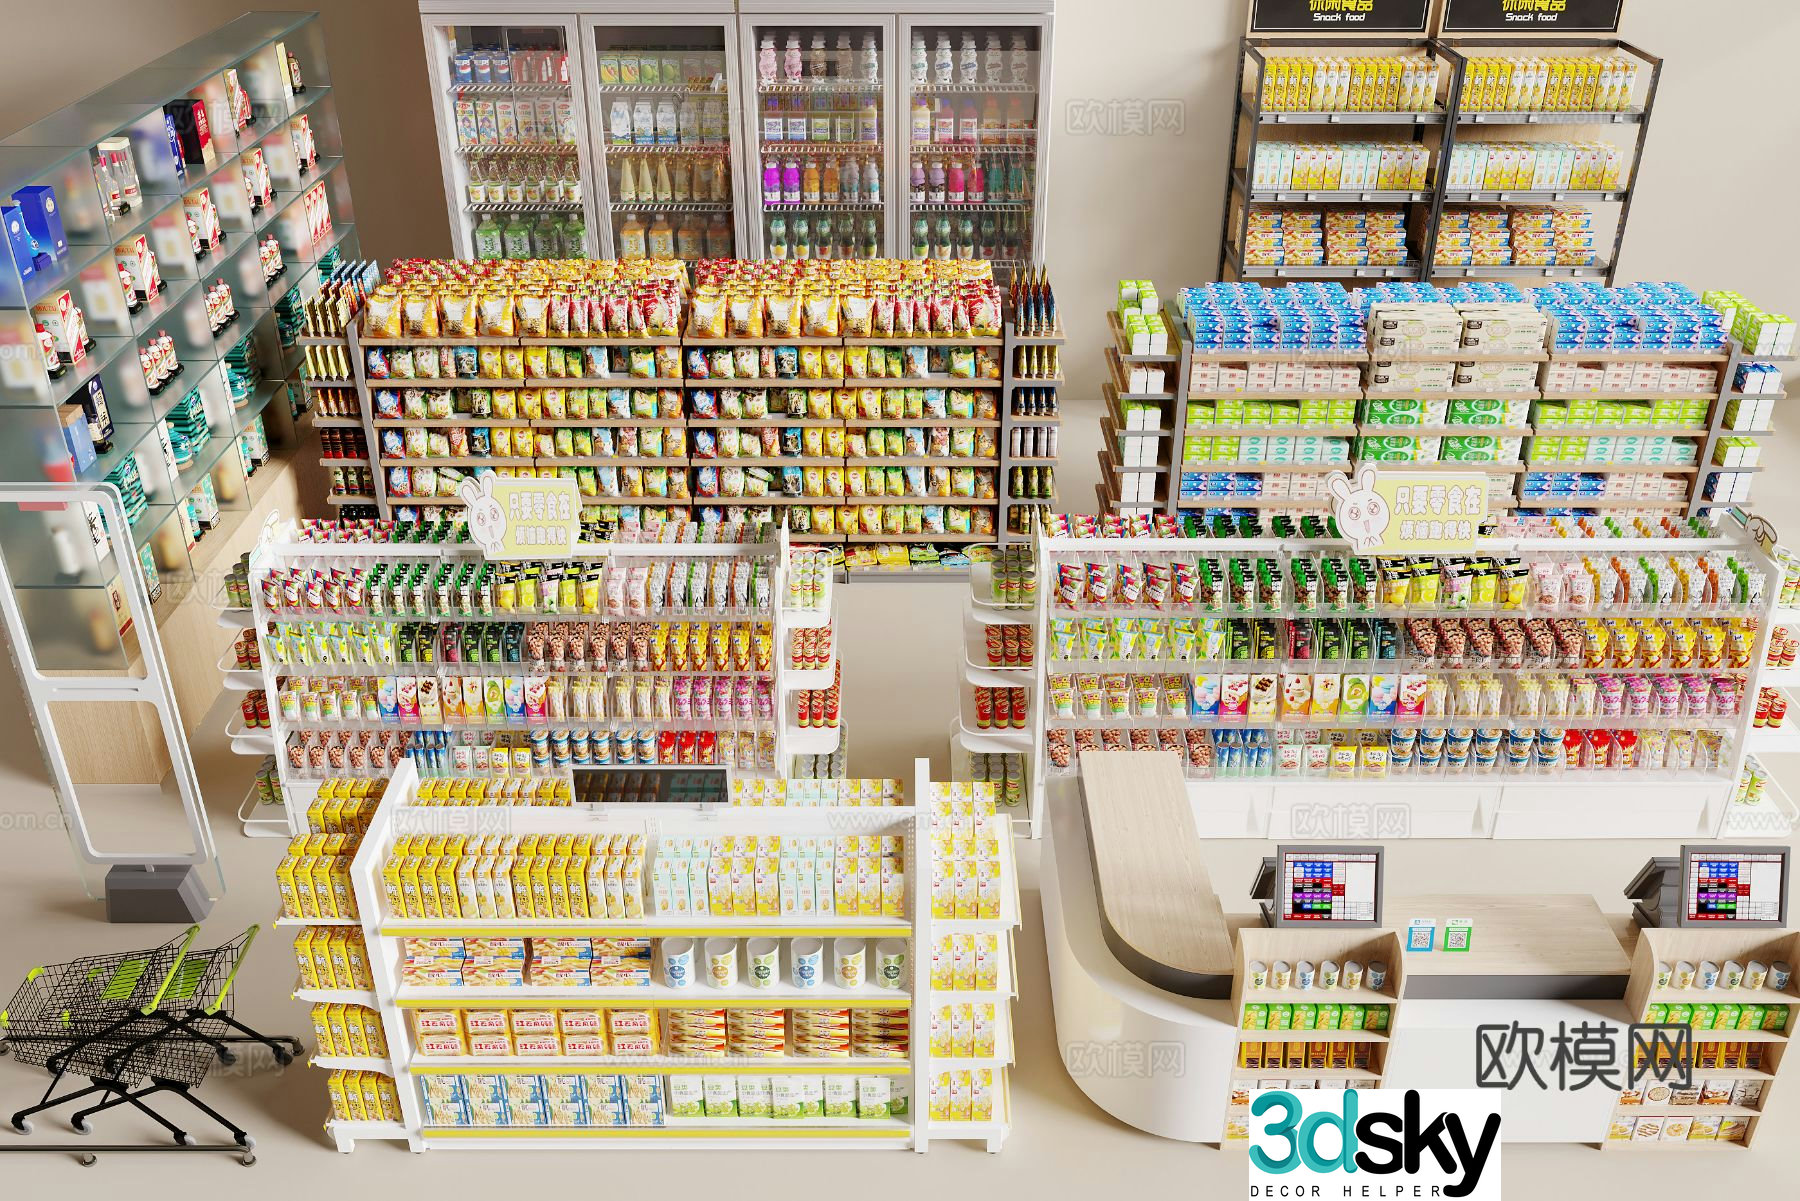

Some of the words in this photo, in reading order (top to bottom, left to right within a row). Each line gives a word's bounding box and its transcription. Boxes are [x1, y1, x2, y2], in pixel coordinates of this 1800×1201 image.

[1313, 13, 1341, 22] Snack
[1345, 13, 1366, 22] food
[1505, 13, 1534, 22] Snack
[1538, 13, 1558, 22] food
[1394, 485, 1482, 515] 只要零食在
